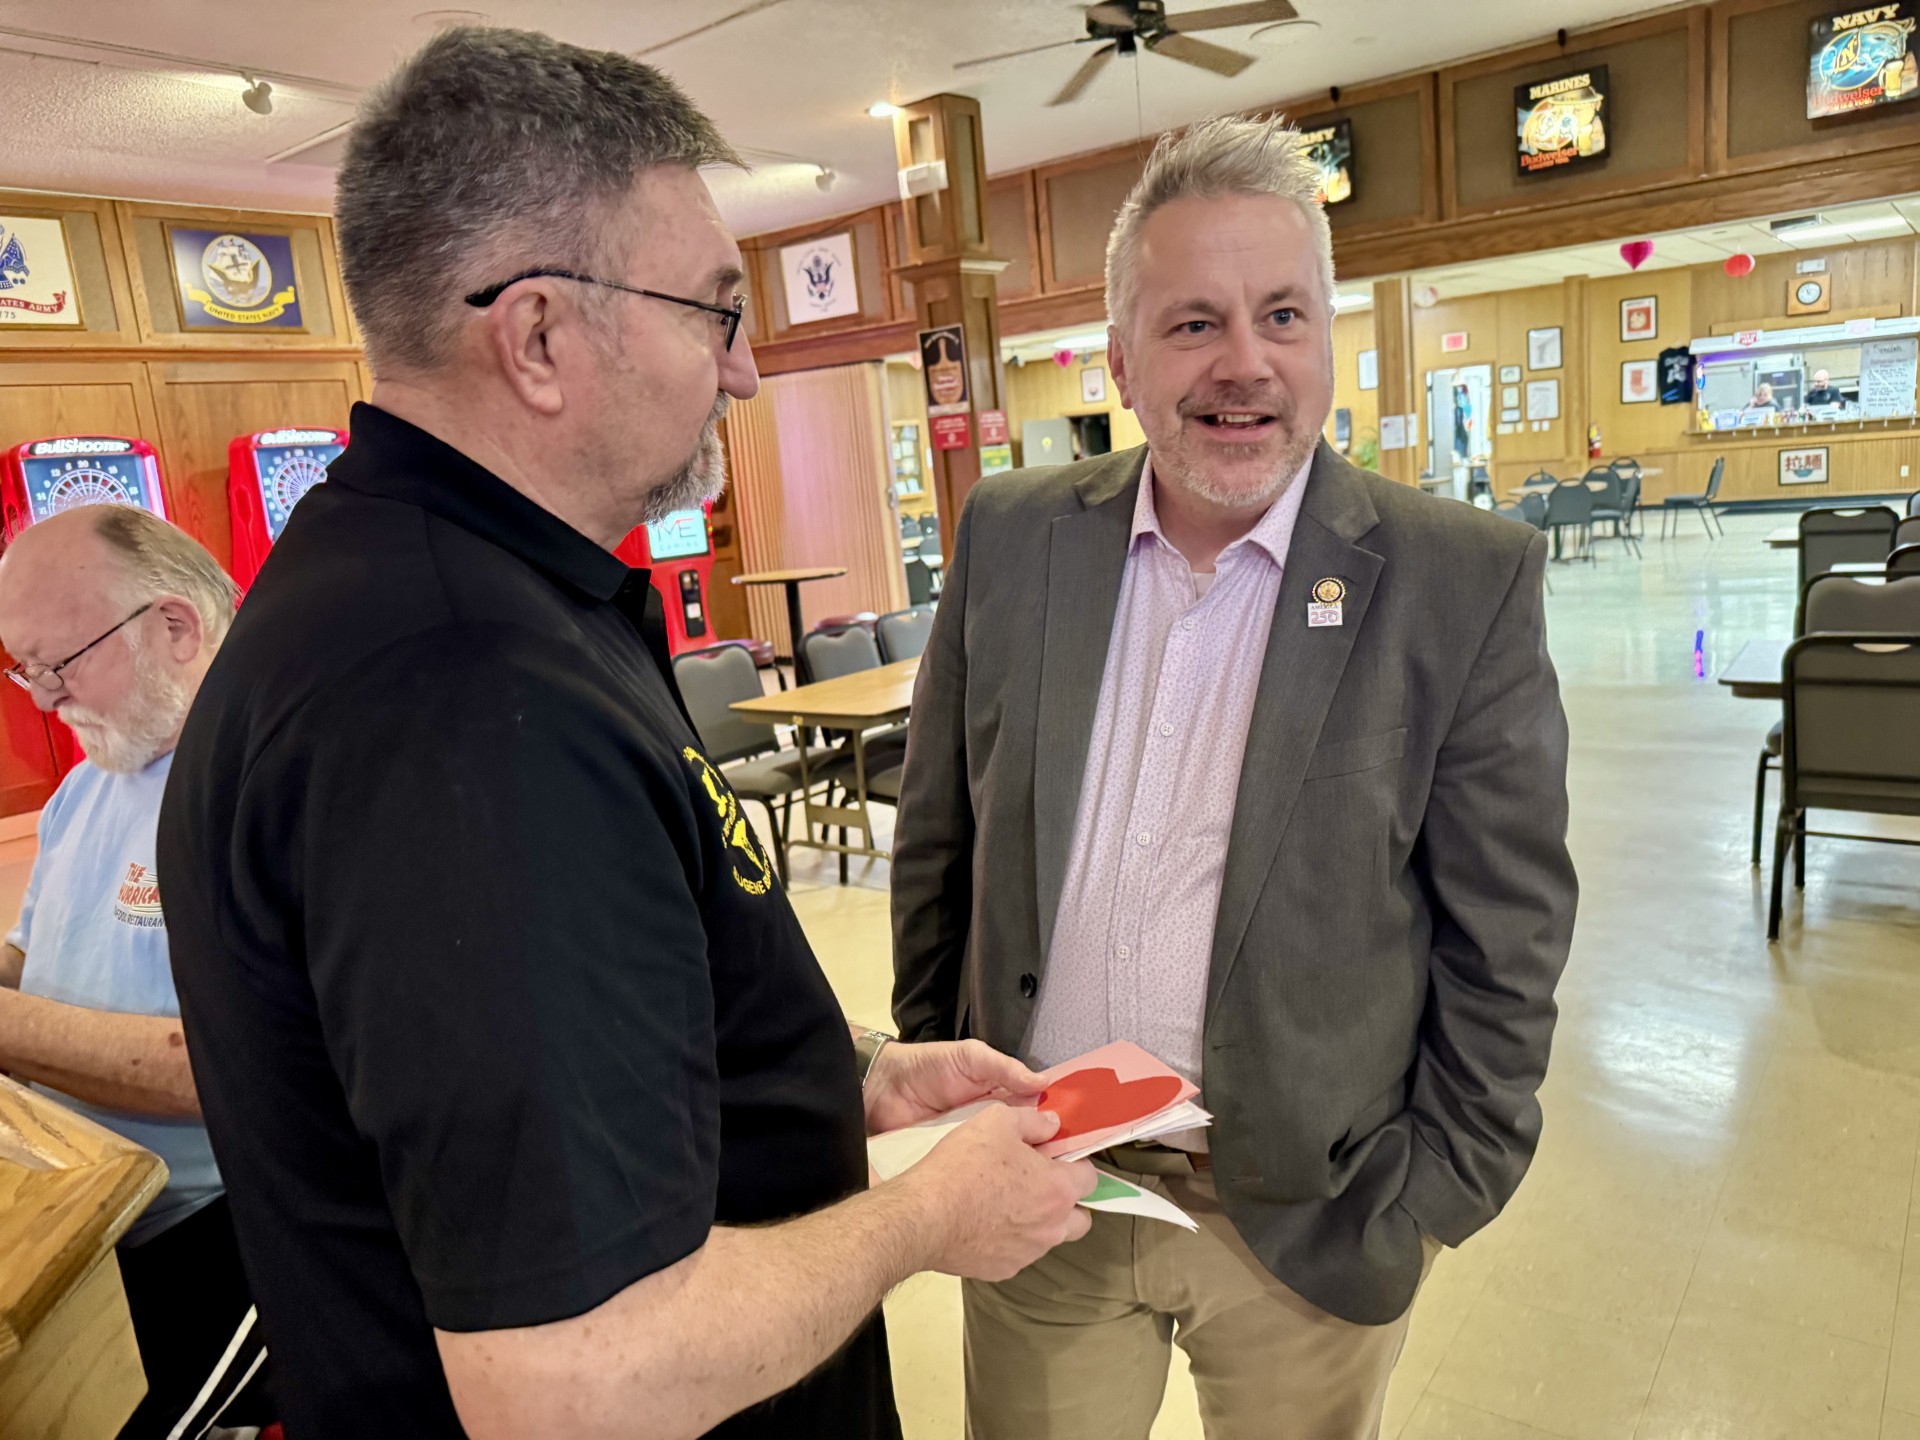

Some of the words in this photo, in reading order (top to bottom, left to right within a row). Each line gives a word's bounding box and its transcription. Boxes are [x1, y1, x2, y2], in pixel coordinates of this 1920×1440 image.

[1832, 3, 1900, 31] NAVY
[1529, 73, 1591, 100] MARINES
[29, 302, 58, 313] ARMY
[1311, 610, 1339, 624] 250
